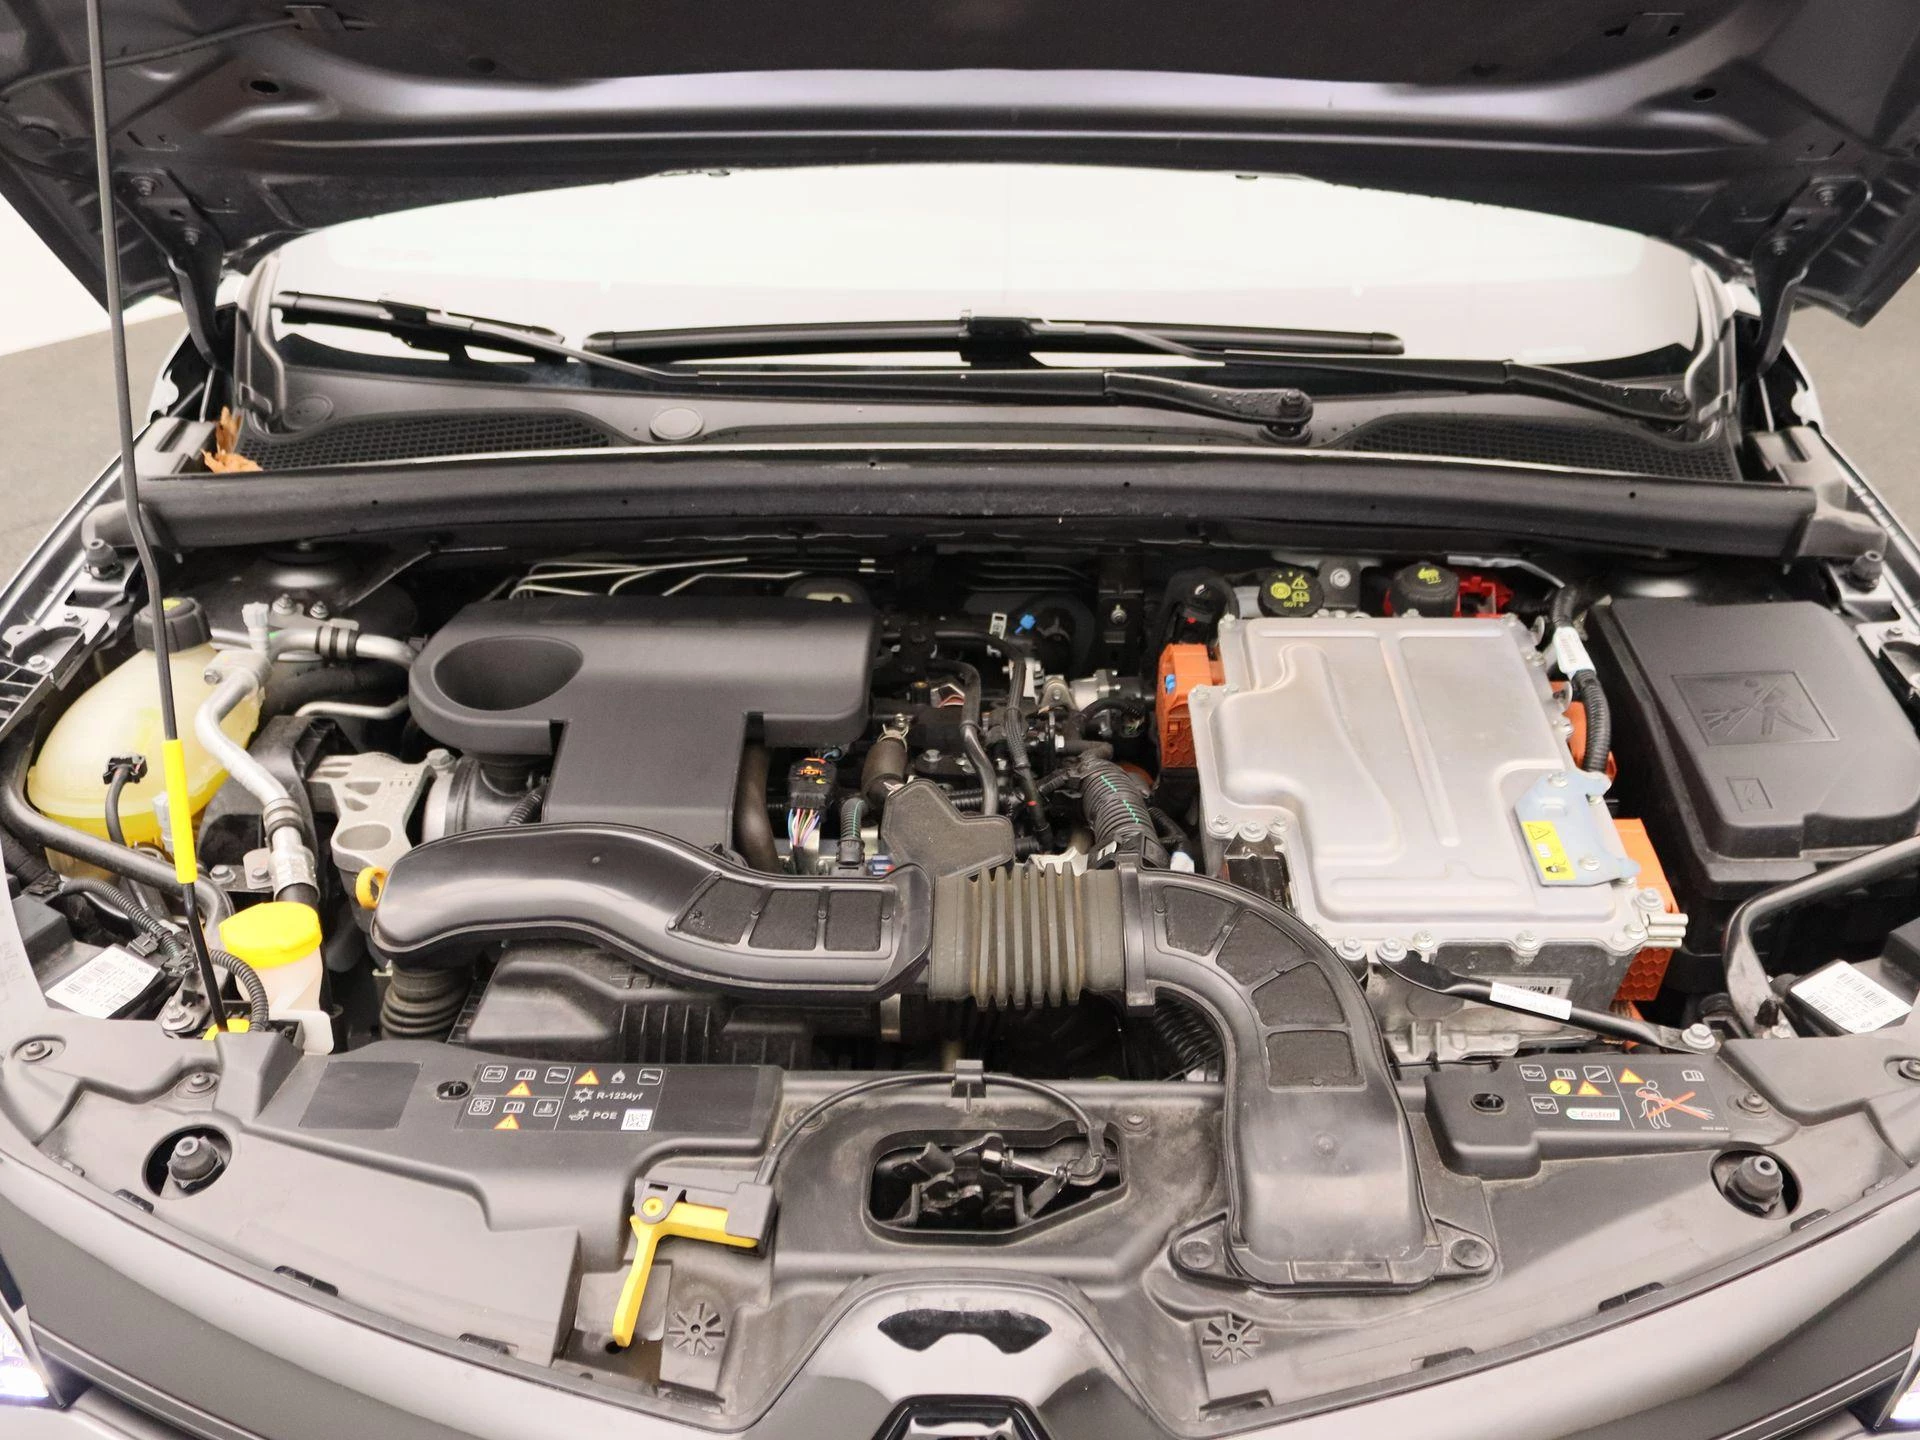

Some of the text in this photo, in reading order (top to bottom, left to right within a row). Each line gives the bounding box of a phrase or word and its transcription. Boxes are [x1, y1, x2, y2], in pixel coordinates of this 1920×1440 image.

[596, 1091, 643, 1102] R-1234yf
[592, 1112, 618, 1120] POE
[1580, 1110, 1617, 1119] Castrol
